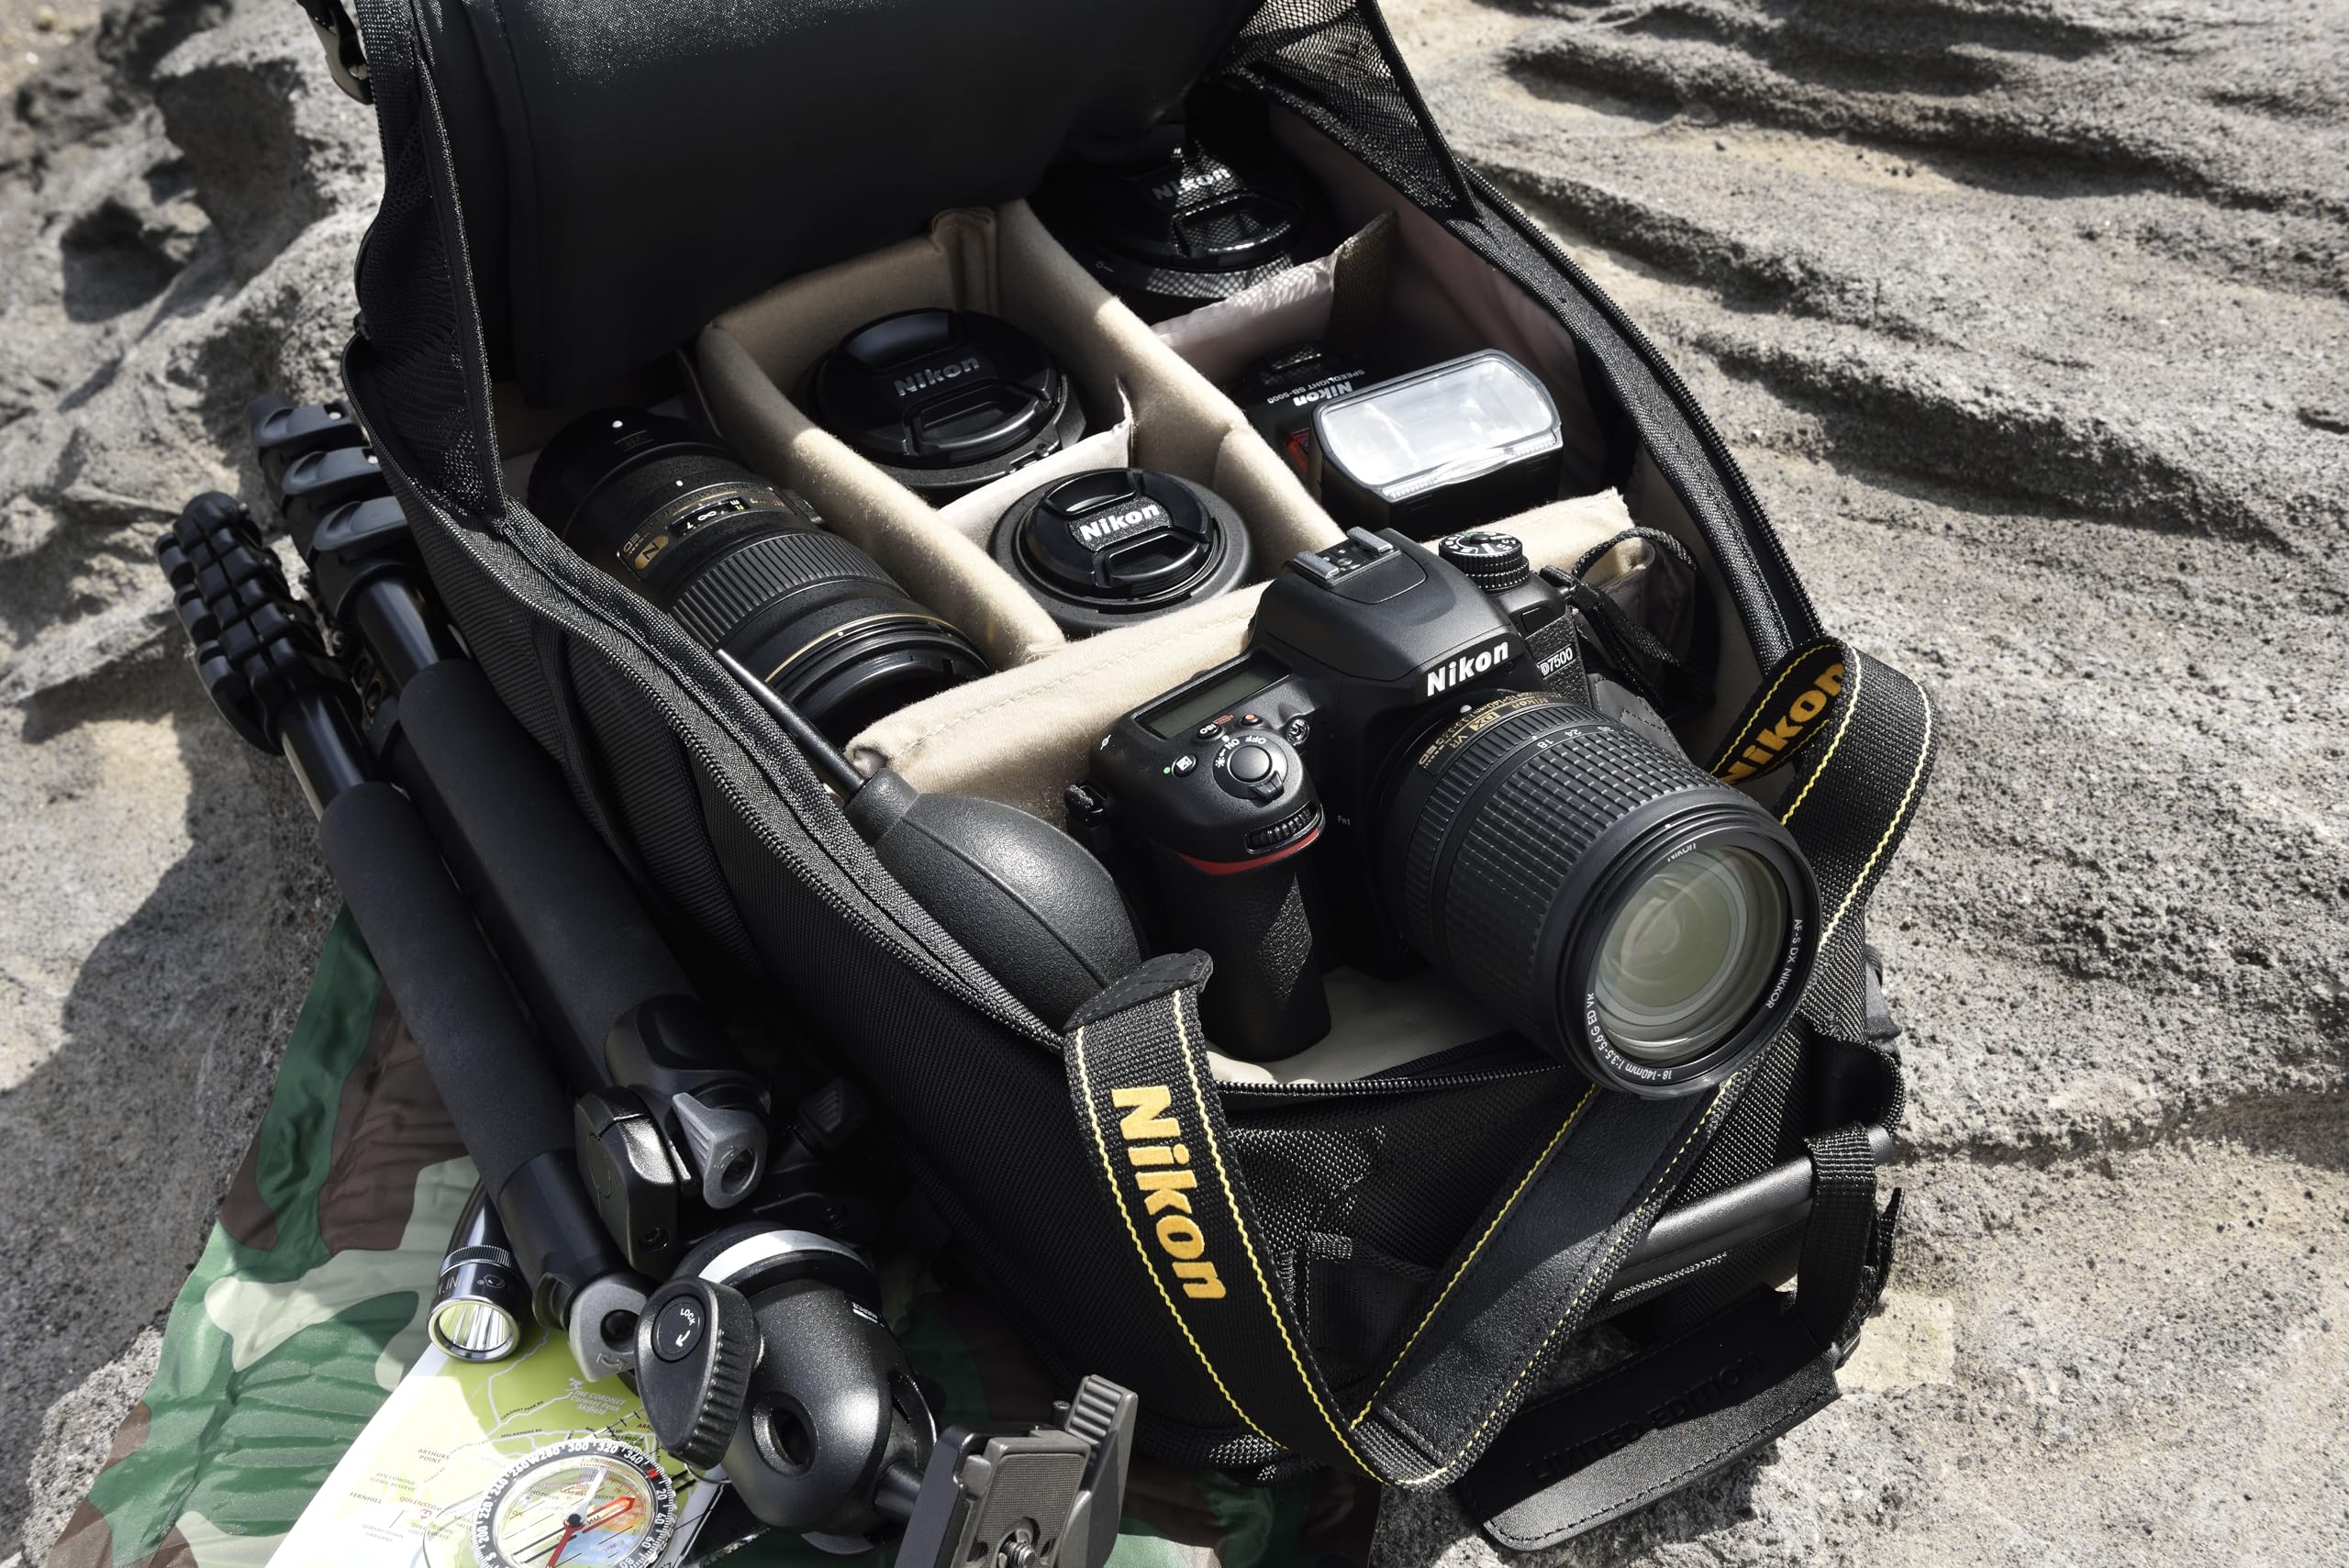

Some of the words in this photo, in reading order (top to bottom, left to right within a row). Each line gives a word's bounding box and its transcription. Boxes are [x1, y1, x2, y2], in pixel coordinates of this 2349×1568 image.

[1152, 167, 1230, 200] Nikon
[893, 356, 981, 396] Nikon
[1308, 369, 1365, 391] SPEEDLIGHT
[1266, 386, 1307, 404] SB-5000
[1292, 381, 1353, 406] Nikon
[1078, 503, 1160, 542] Nikon
[1427, 641, 1508, 697] Nikon
[1539, 646, 1574, 676] D7500
[1199, 723, 1218, 735] ISO
[1564, 728, 1582, 737] 24
[1224, 738, 1241, 751] ON
[1245, 735, 1267, 745] OFF
[1450, 735, 1468, 749] VR
[1537, 738, 1554, 750] 18
[1792, 918, 1803, 944] AF-S
[1787, 947, 1798, 963] DX
[1765, 968, 1793, 1009] NIKKOR
[1586, 1010, 1598, 1025] ED
[1110, 1084, 1227, 1299] Nikon
[680, 1307, 696, 1327] LOCK
[1525, 1423, 1642, 1483] LIMITED
[1647, 1351, 1763, 1429] EDITION
[417, 1448, 451, 1461] ARTHURS
[567, 1441, 589, 1452] 300
[596, 1442, 618, 1454] 320
[418, 1454, 442, 1464] POINT
[624, 1449, 644, 1464] 340
[491, 1477, 509, 1496] 240
[655, 1488, 668, 1501] 20
[349, 1492, 383, 1505] FERNHILL
[478, 1500, 494, 1519] 220
[655, 1512, 667, 1525] 40
[476, 1525, 490, 1544] 200
[642, 1536, 655, 1550] 60
